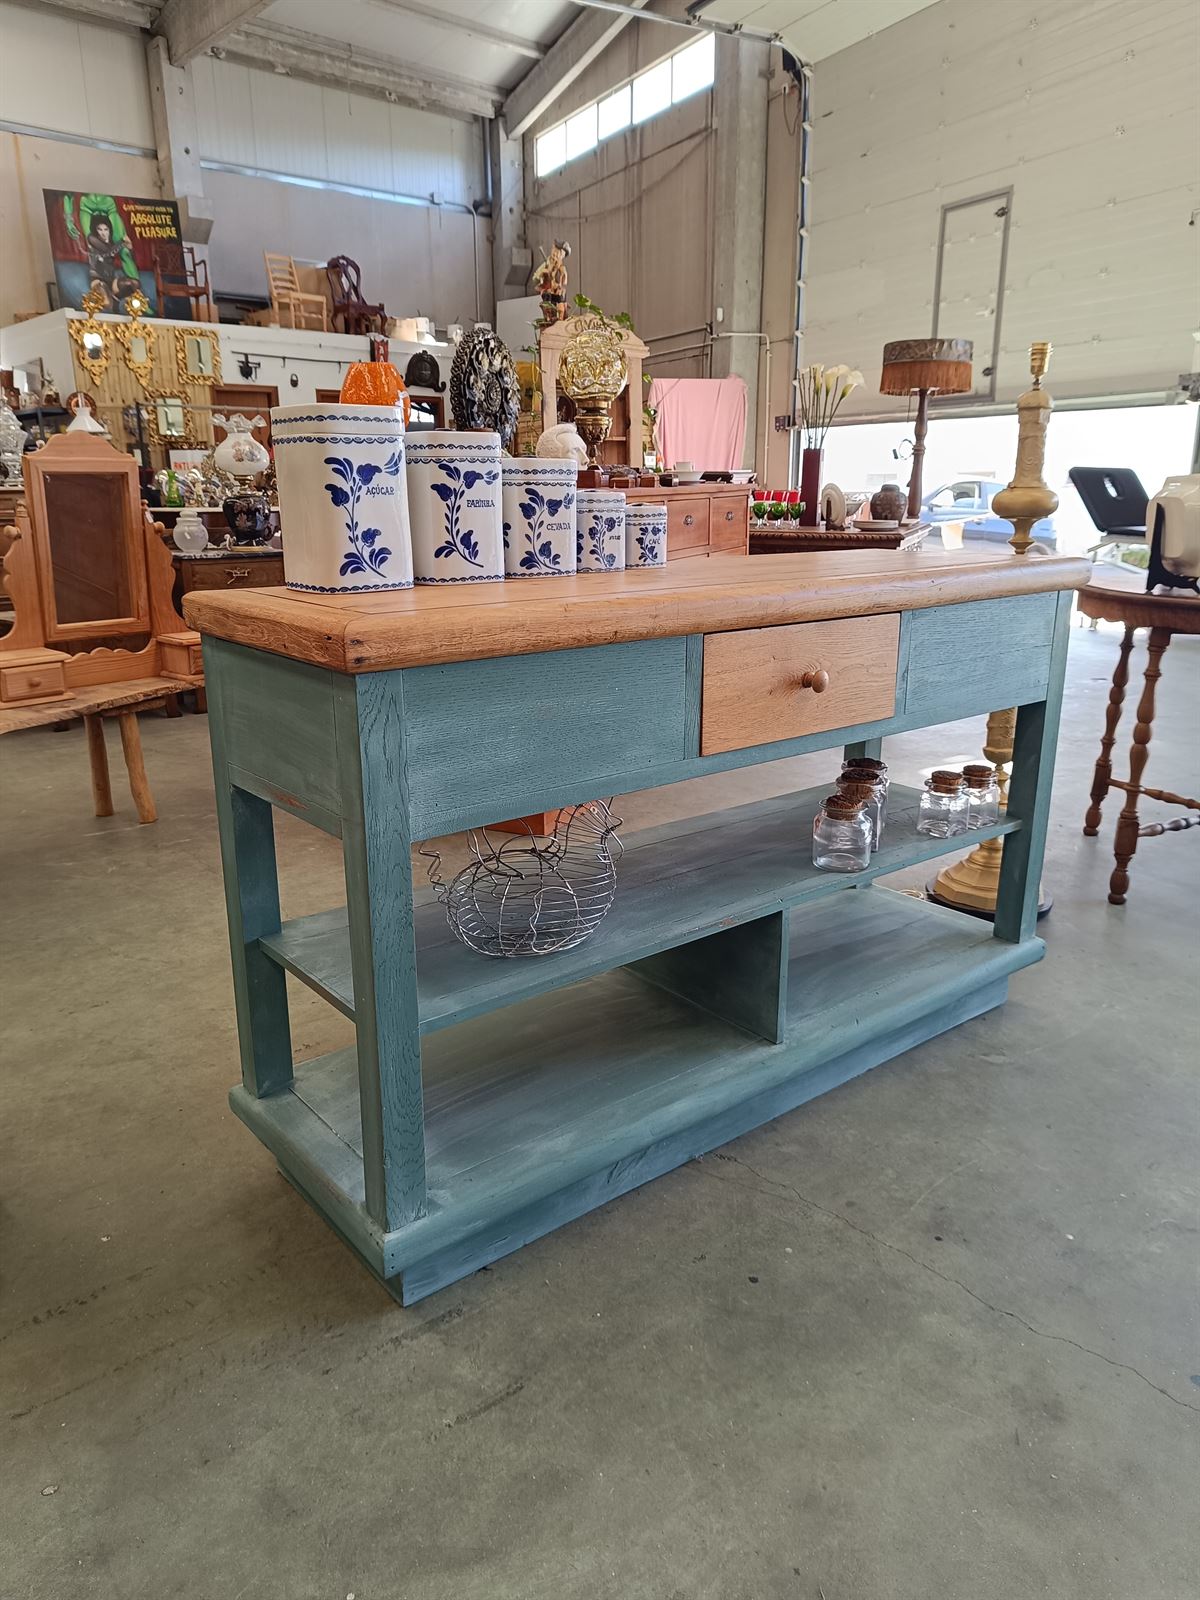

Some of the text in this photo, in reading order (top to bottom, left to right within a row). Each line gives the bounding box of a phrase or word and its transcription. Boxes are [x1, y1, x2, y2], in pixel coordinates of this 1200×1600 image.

[130, 212, 172, 225] ABSOLUTE
[134, 226, 177, 238] PLEASURE
[365, 483, 395, 498] AÇÚCAR
